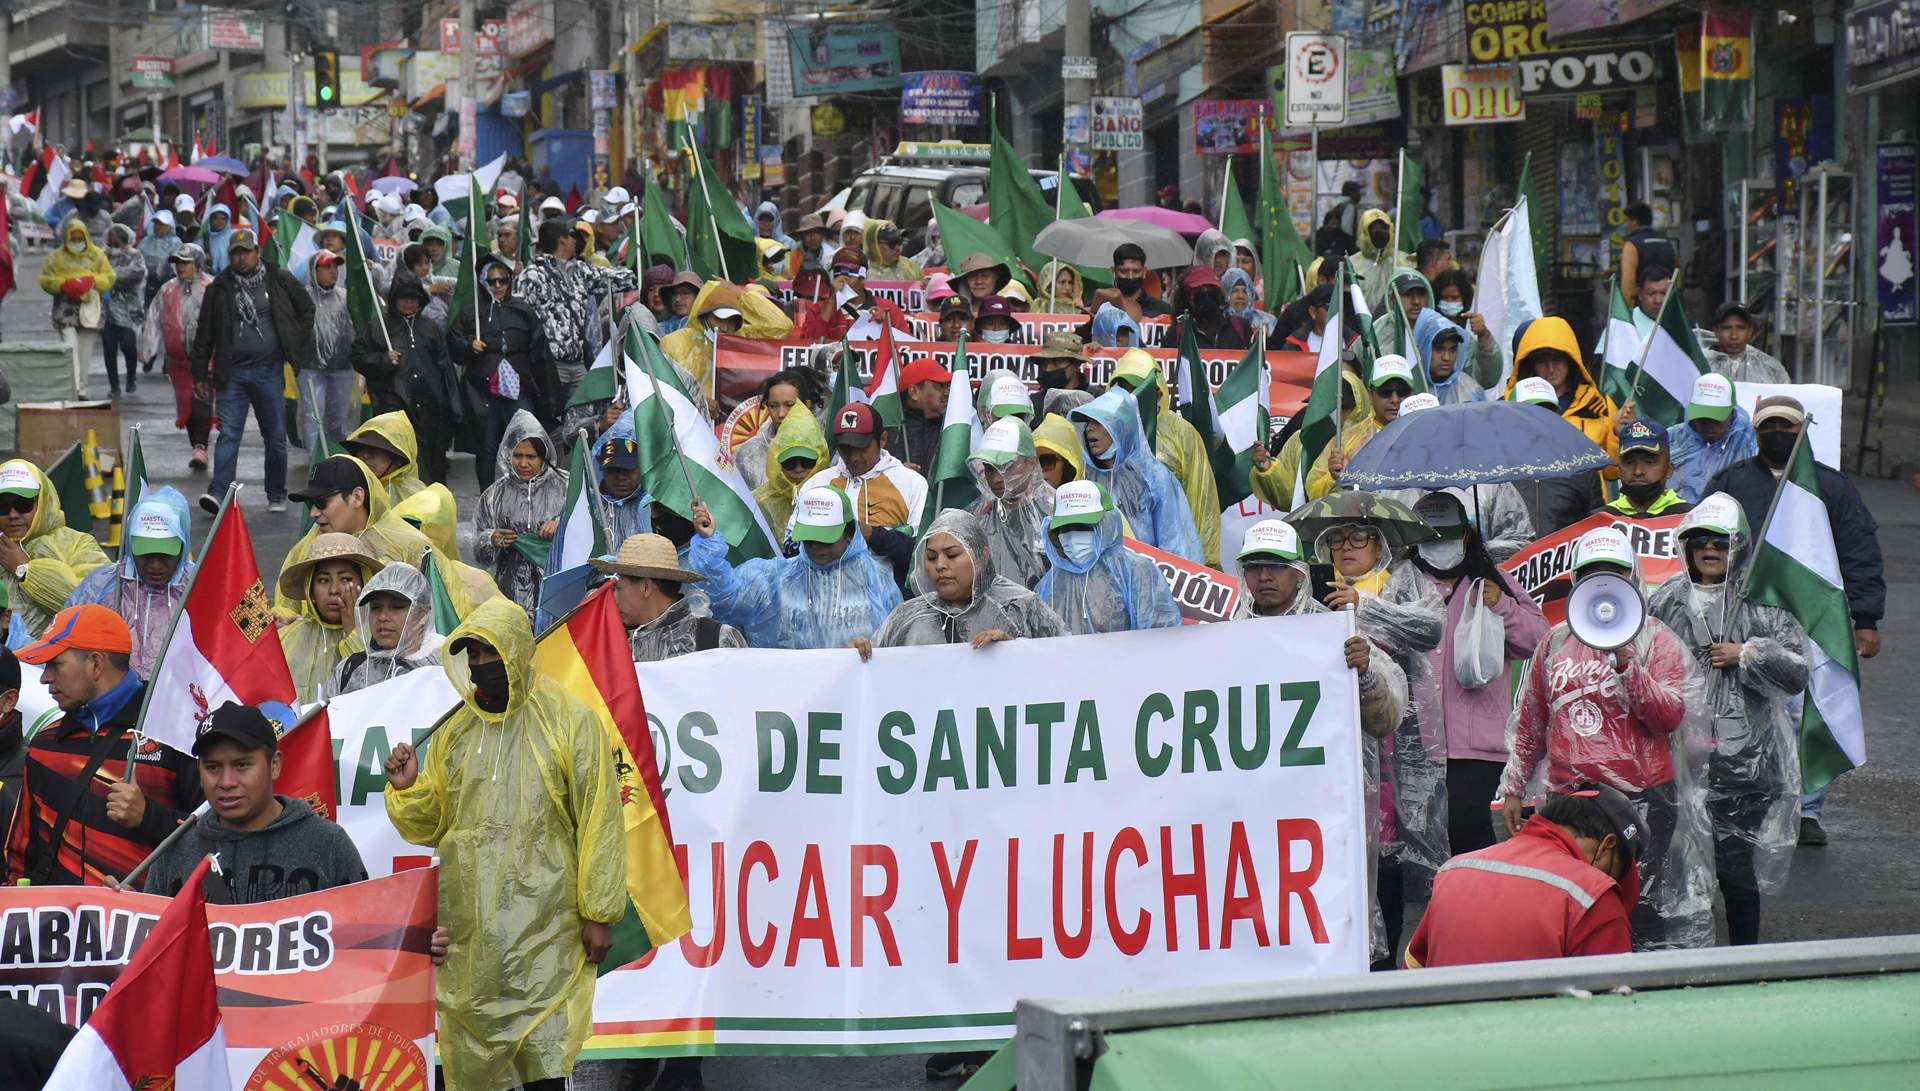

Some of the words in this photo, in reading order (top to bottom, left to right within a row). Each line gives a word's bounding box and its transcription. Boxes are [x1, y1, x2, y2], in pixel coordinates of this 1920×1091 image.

[1467, 1, 1546, 24] COMPR
[1519, 51, 1655, 92] FOTO
[1310, 91, 1322, 99] NO
[1291, 103, 1342, 113] ESTACIONAR
[756, 711, 842, 795] DE
[876, 700, 1107, 795] SANTA
[1135, 680, 1326, 778] CRUZ
[612, 838, 903, 971] UCAR
[930, 839, 979, 965] Y
[1007, 818, 1330, 962] LUCHAR
[368, 1026, 385, 1037] DE
